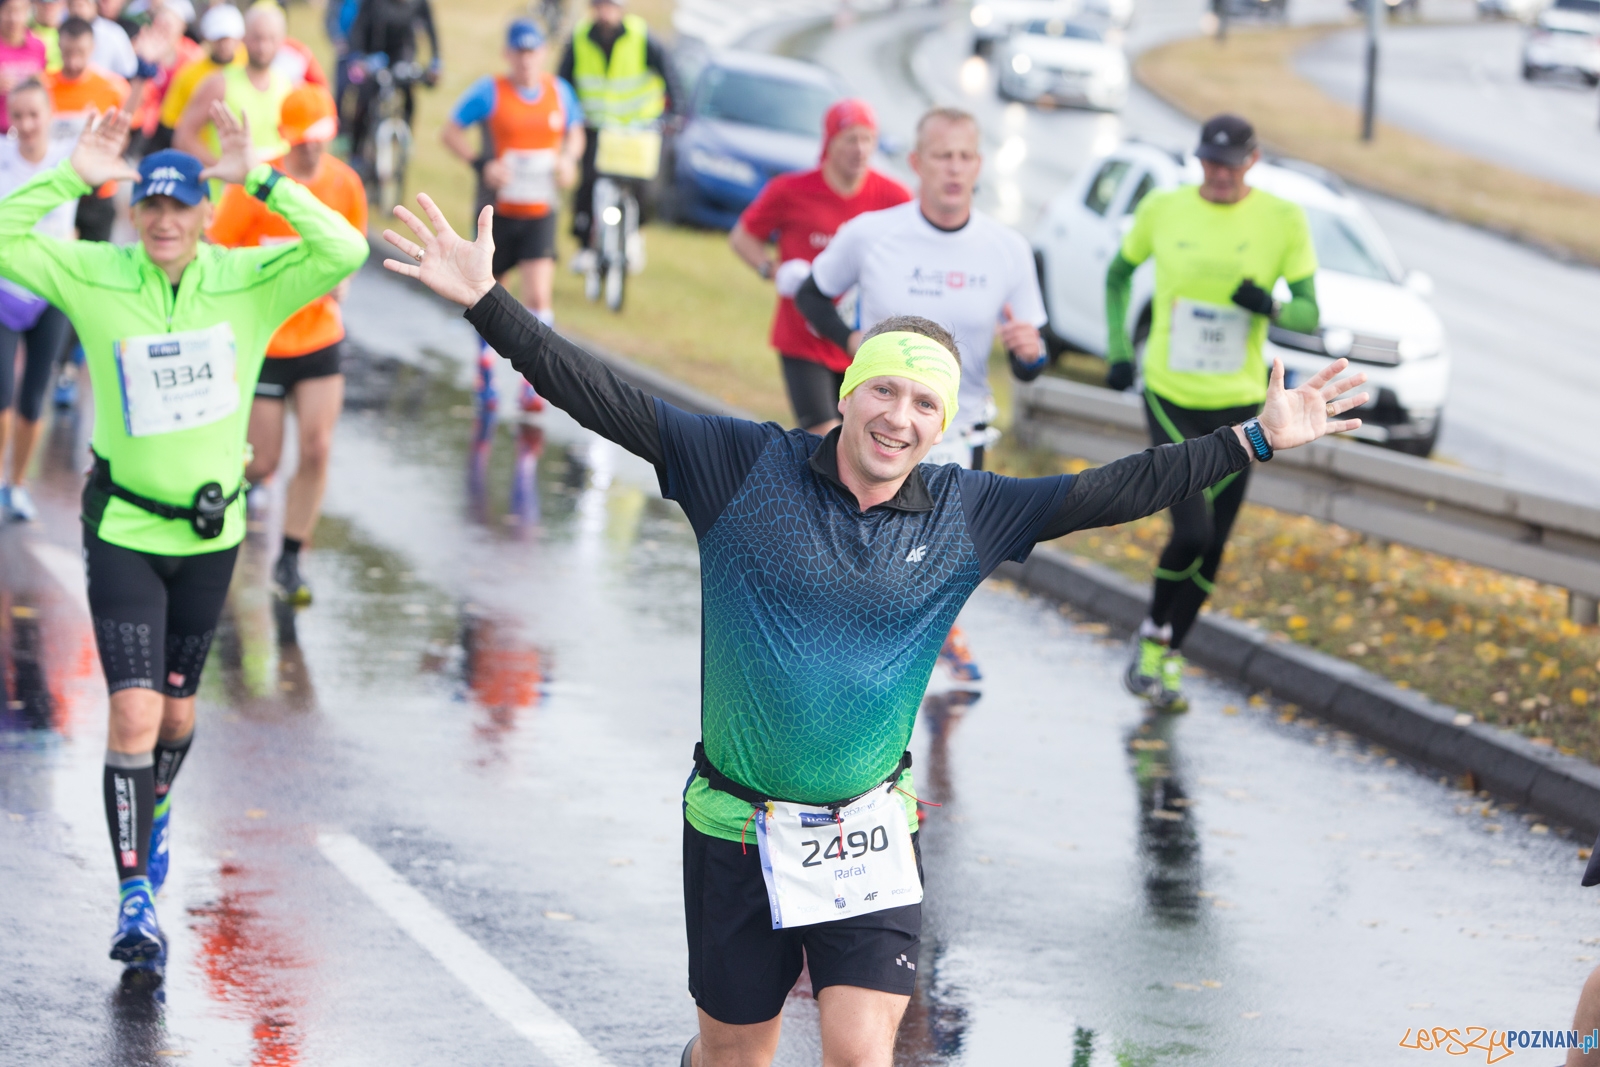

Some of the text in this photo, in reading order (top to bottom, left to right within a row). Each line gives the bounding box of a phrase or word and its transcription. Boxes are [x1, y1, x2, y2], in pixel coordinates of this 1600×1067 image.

[152, 361, 213, 390] 1334
[905, 545, 926, 563] 4F
[801, 824, 889, 868] 2490
[834, 863, 867, 881] Rafał
[863, 891, 879, 902] 4F
